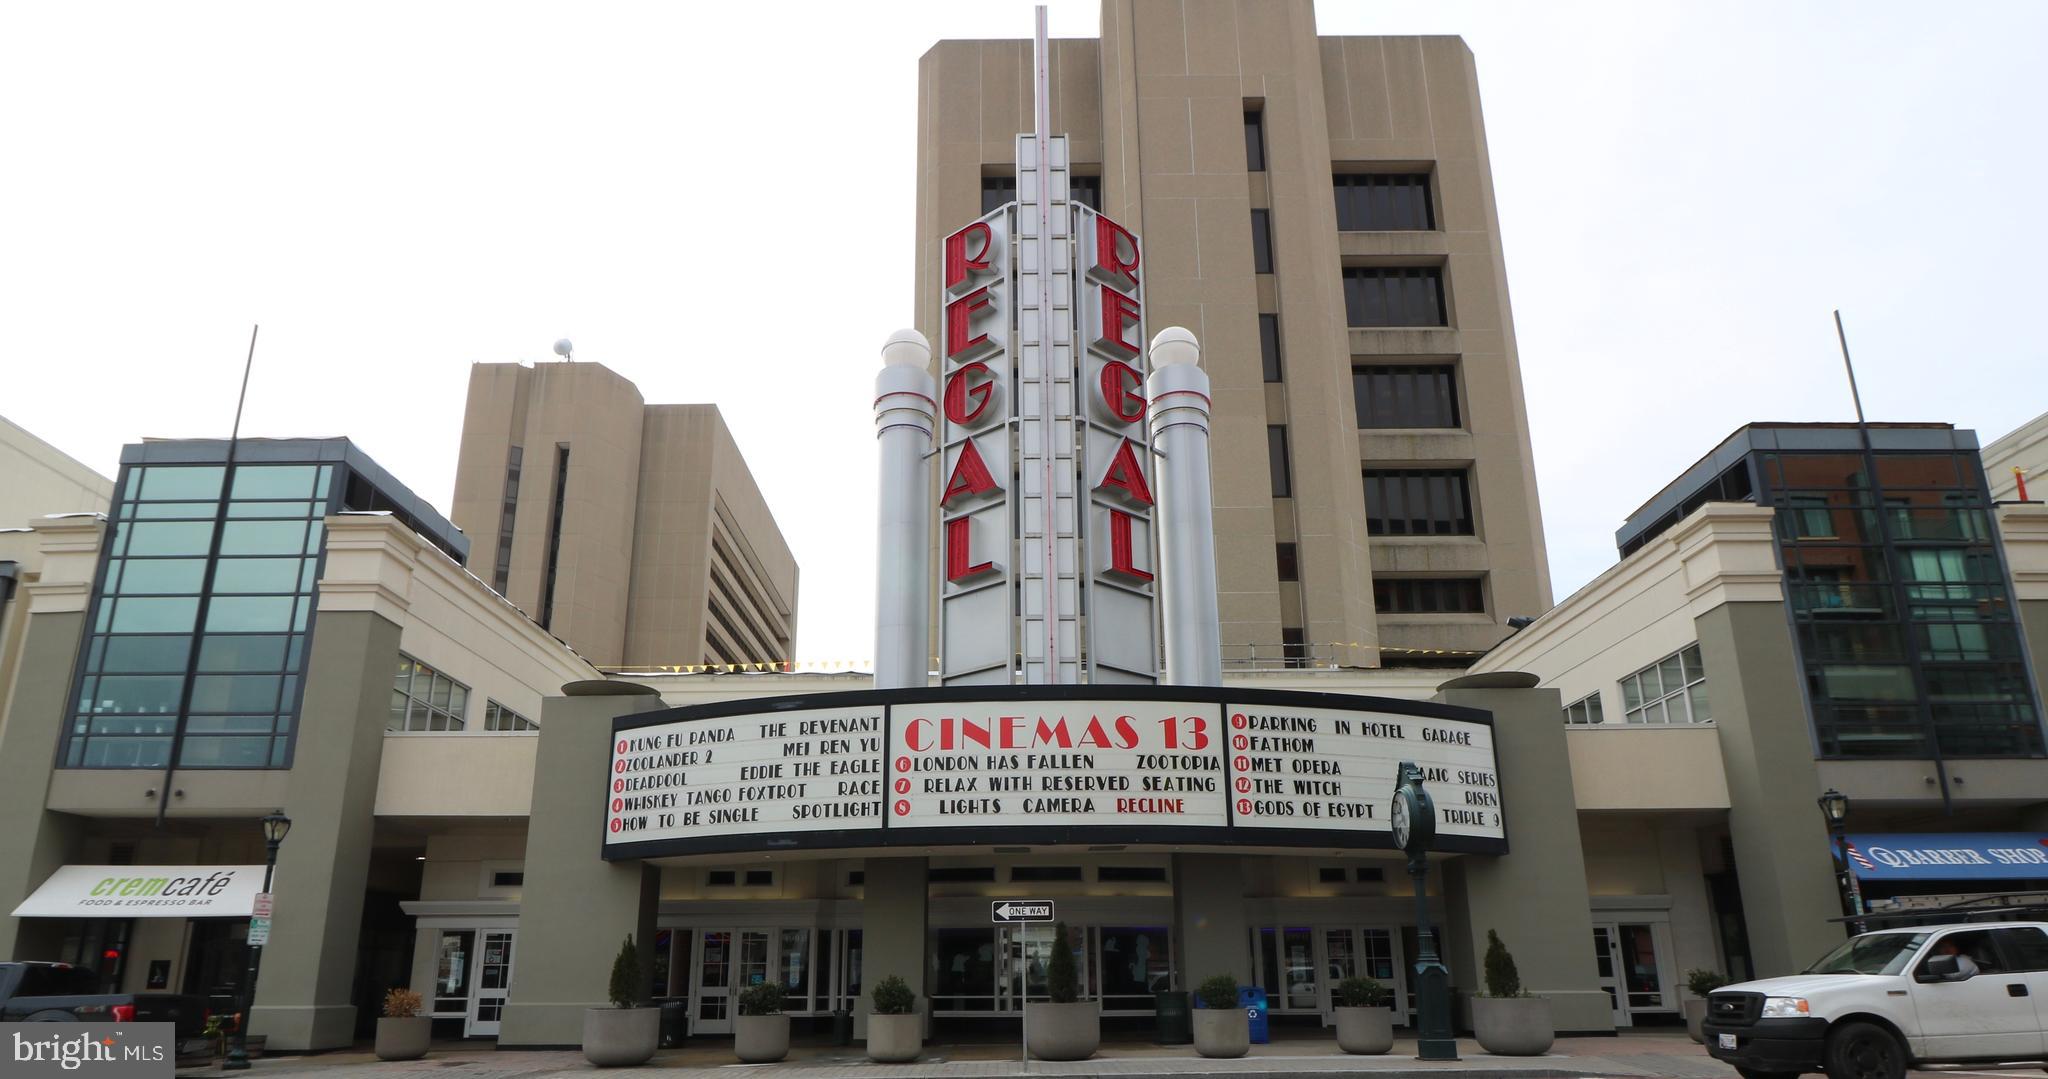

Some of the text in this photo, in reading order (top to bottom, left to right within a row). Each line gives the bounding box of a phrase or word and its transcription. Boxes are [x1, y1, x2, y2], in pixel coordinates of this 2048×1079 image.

[941, 222, 999, 581] REGAL
[1092, 216, 1153, 580] REGAL
[760, 717, 880, 738] THE REVENANT
[905, 715, 1208, 751] CINEMAS 13
[1249, 715, 1317, 732] PARKING
[1335, 721, 1350, 734] IN
[1362, 722, 1405, 739] HOTEL
[1423, 728, 1471, 745] GARAGE
[630, 738, 661, 752] KUNG
[667, 733, 683, 748] FU
[690, 728, 735, 745] PANDA
[783, 738, 880, 757] MEI REN YU
[1251, 736, 1314, 752] FATHOM
[626, 751, 698, 772] ZOOLANDER
[705, 750, 712, 764] 2
[740, 759, 880, 780] EDDIE THE EAGLE
[913, 756, 978, 771] LONDON
[987, 755, 1019, 770] HAS
[1027, 755, 1094, 770] FALLEN
[1136, 755, 1221, 770] ZOOTOPIA
[1252, 758, 1282, 772] MET
[1293, 759, 1341, 775] OPERA
[625, 772, 687, 792] DEADPOOL
[838, 780, 880, 796] RACE
[924, 777, 977, 793] RELAX
[989, 777, 1032, 791] WITH
[1042, 776, 1130, 791] RESERVED
[1142, 777, 1215, 792] SEATING
[1254, 779, 1283, 794] THE
[1294, 780, 1341, 796] WITCH
[1458, 771, 1495, 787] SERIES
[624, 793, 678, 811] WHISKEY
[687, 788, 731, 805] TANGO
[739, 784, 807, 801] FOXTROT
[940, 799, 1001, 814] LIGHTS
[1023, 798, 1095, 813] CAMERA
[1117, 798, 1184, 813] RECLINE
[1465, 791, 1497, 807] RISEN
[792, 801, 881, 819] SPOTLIGHT
[1254, 801, 1294, 816] GODS
[1303, 802, 1321, 816] OF
[1329, 803, 1373, 818] EGYPT
[1443, 809, 1499, 827] TRIPLE 9
[622, 816, 648, 831] HOW
[659, 814, 675, 828] TO
[684, 812, 700, 826] BE
[709, 807, 759, 824] SINGLE
[1895, 849, 1992, 865] BARBER
